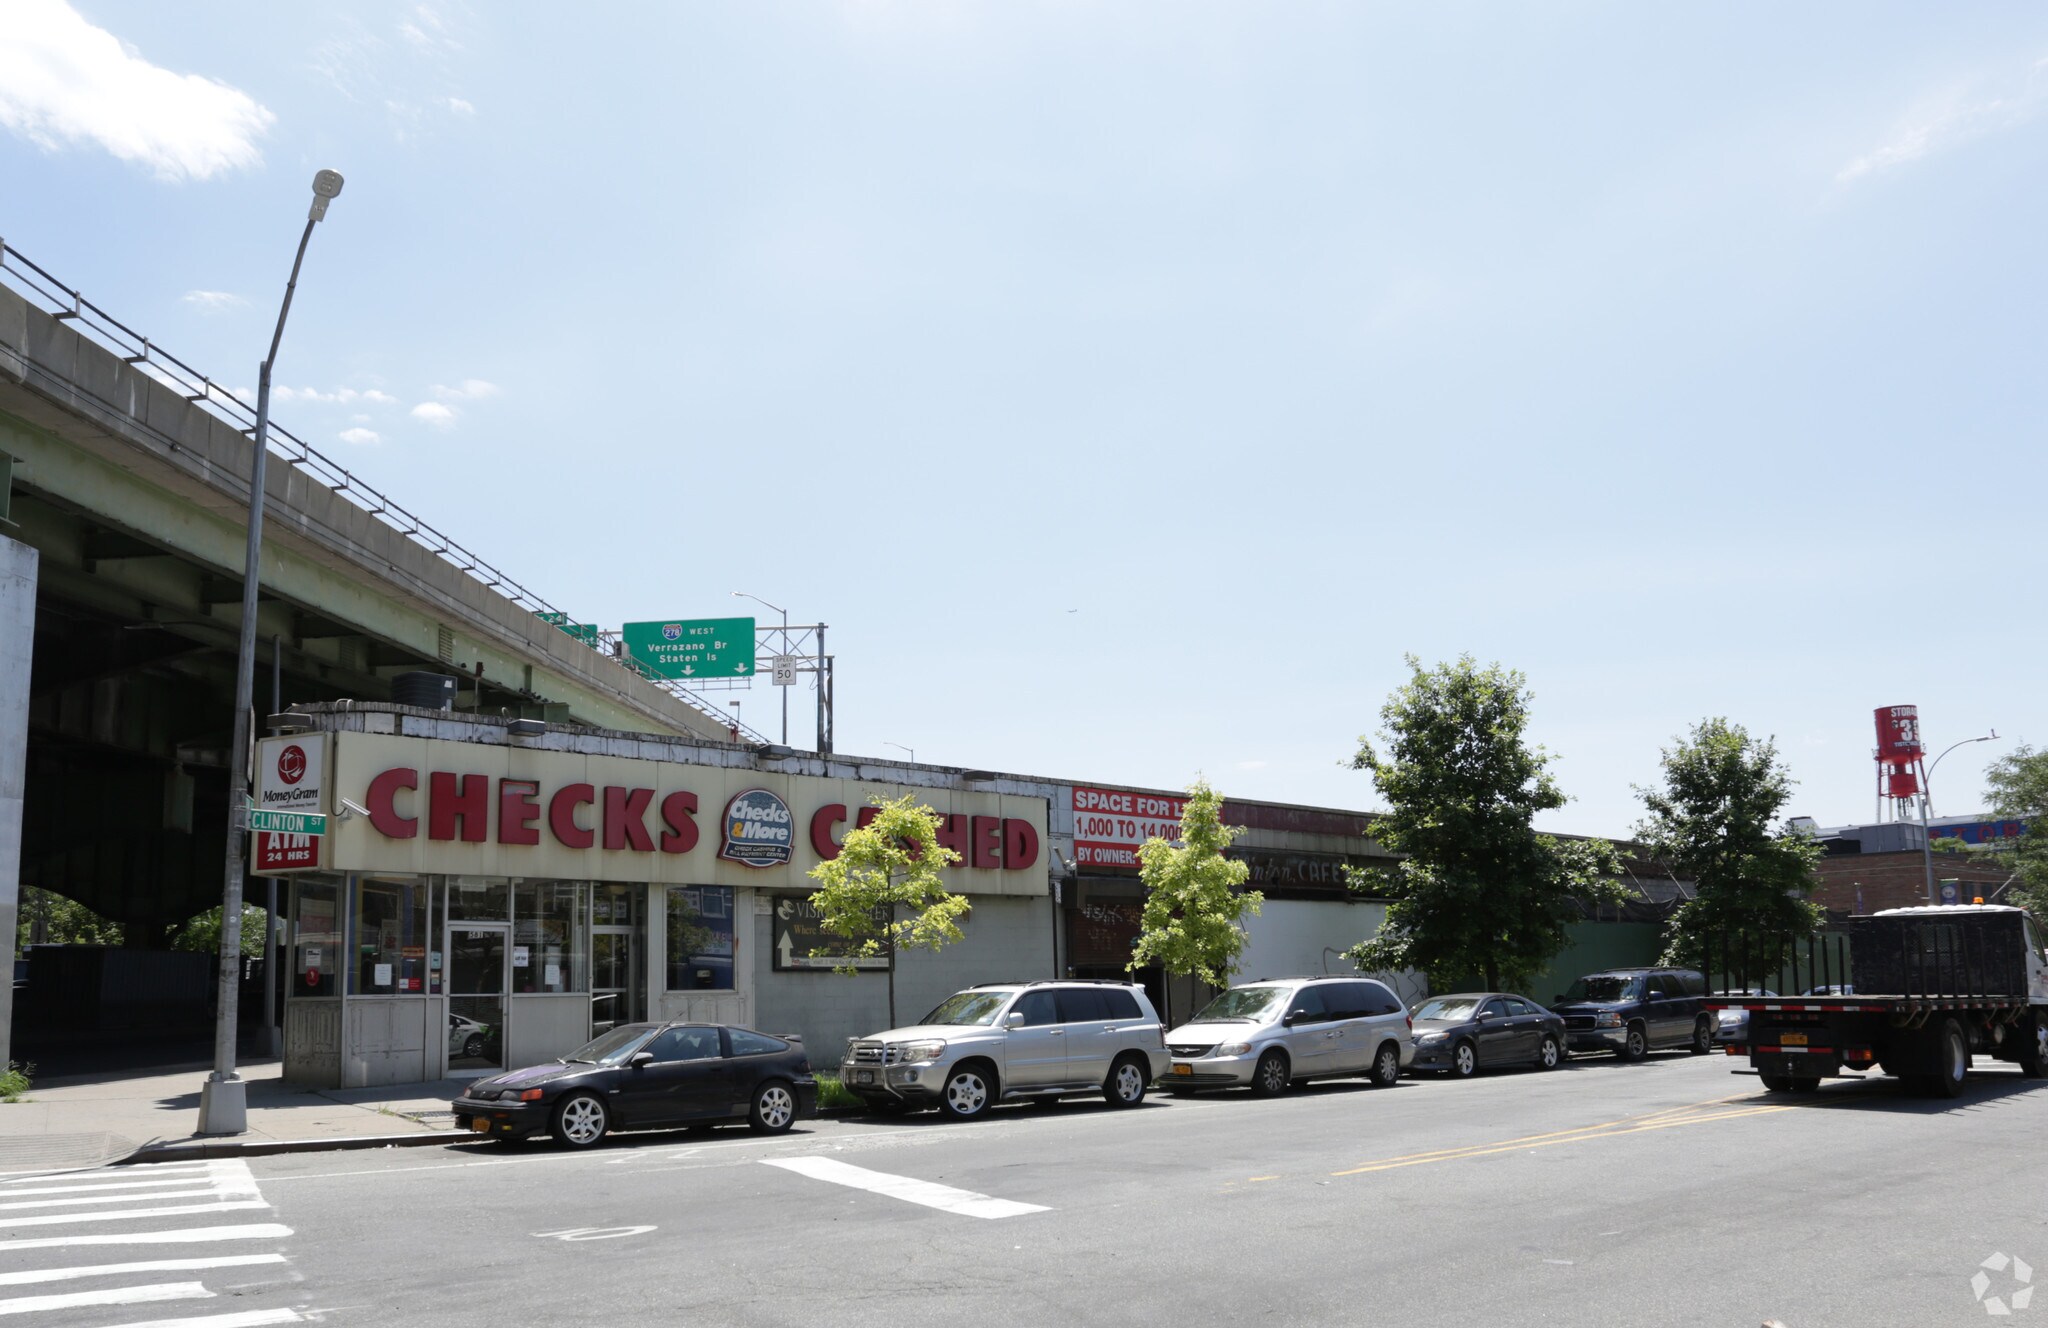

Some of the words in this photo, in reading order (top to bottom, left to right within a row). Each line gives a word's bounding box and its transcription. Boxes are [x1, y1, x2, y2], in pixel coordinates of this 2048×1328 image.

[665, 629, 680, 637] 278
[689, 627, 715, 635] WEST
[648, 643, 705, 652] Verrazano
[714, 641, 727, 649] Br
[659, 654, 698, 663] Staten
[707, 653, 717, 661] Is
[777, 669, 791, 679] 50
[262, 788, 319, 803] MoneyGram
[1075, 791, 1133, 813] SPACE
[1137, 798, 1170, 816] FOR
[366, 767, 700, 853] CHECKS
[810, 803, 1039, 870] CHED
[730, 800, 789, 823] Checks
[252, 812, 304, 831] CLINTON
[311, 817, 323, 826] ST
[1076, 816, 1114, 839] 1,000
[1117, 819, 1136, 838] TO
[267, 852, 282, 862] 24
[288, 850, 310, 861] HRS
[1077, 847, 1091, 862] BY
[1094, 848, 1136, 865] OWNER:
[793, 924, 816, 935] Where
